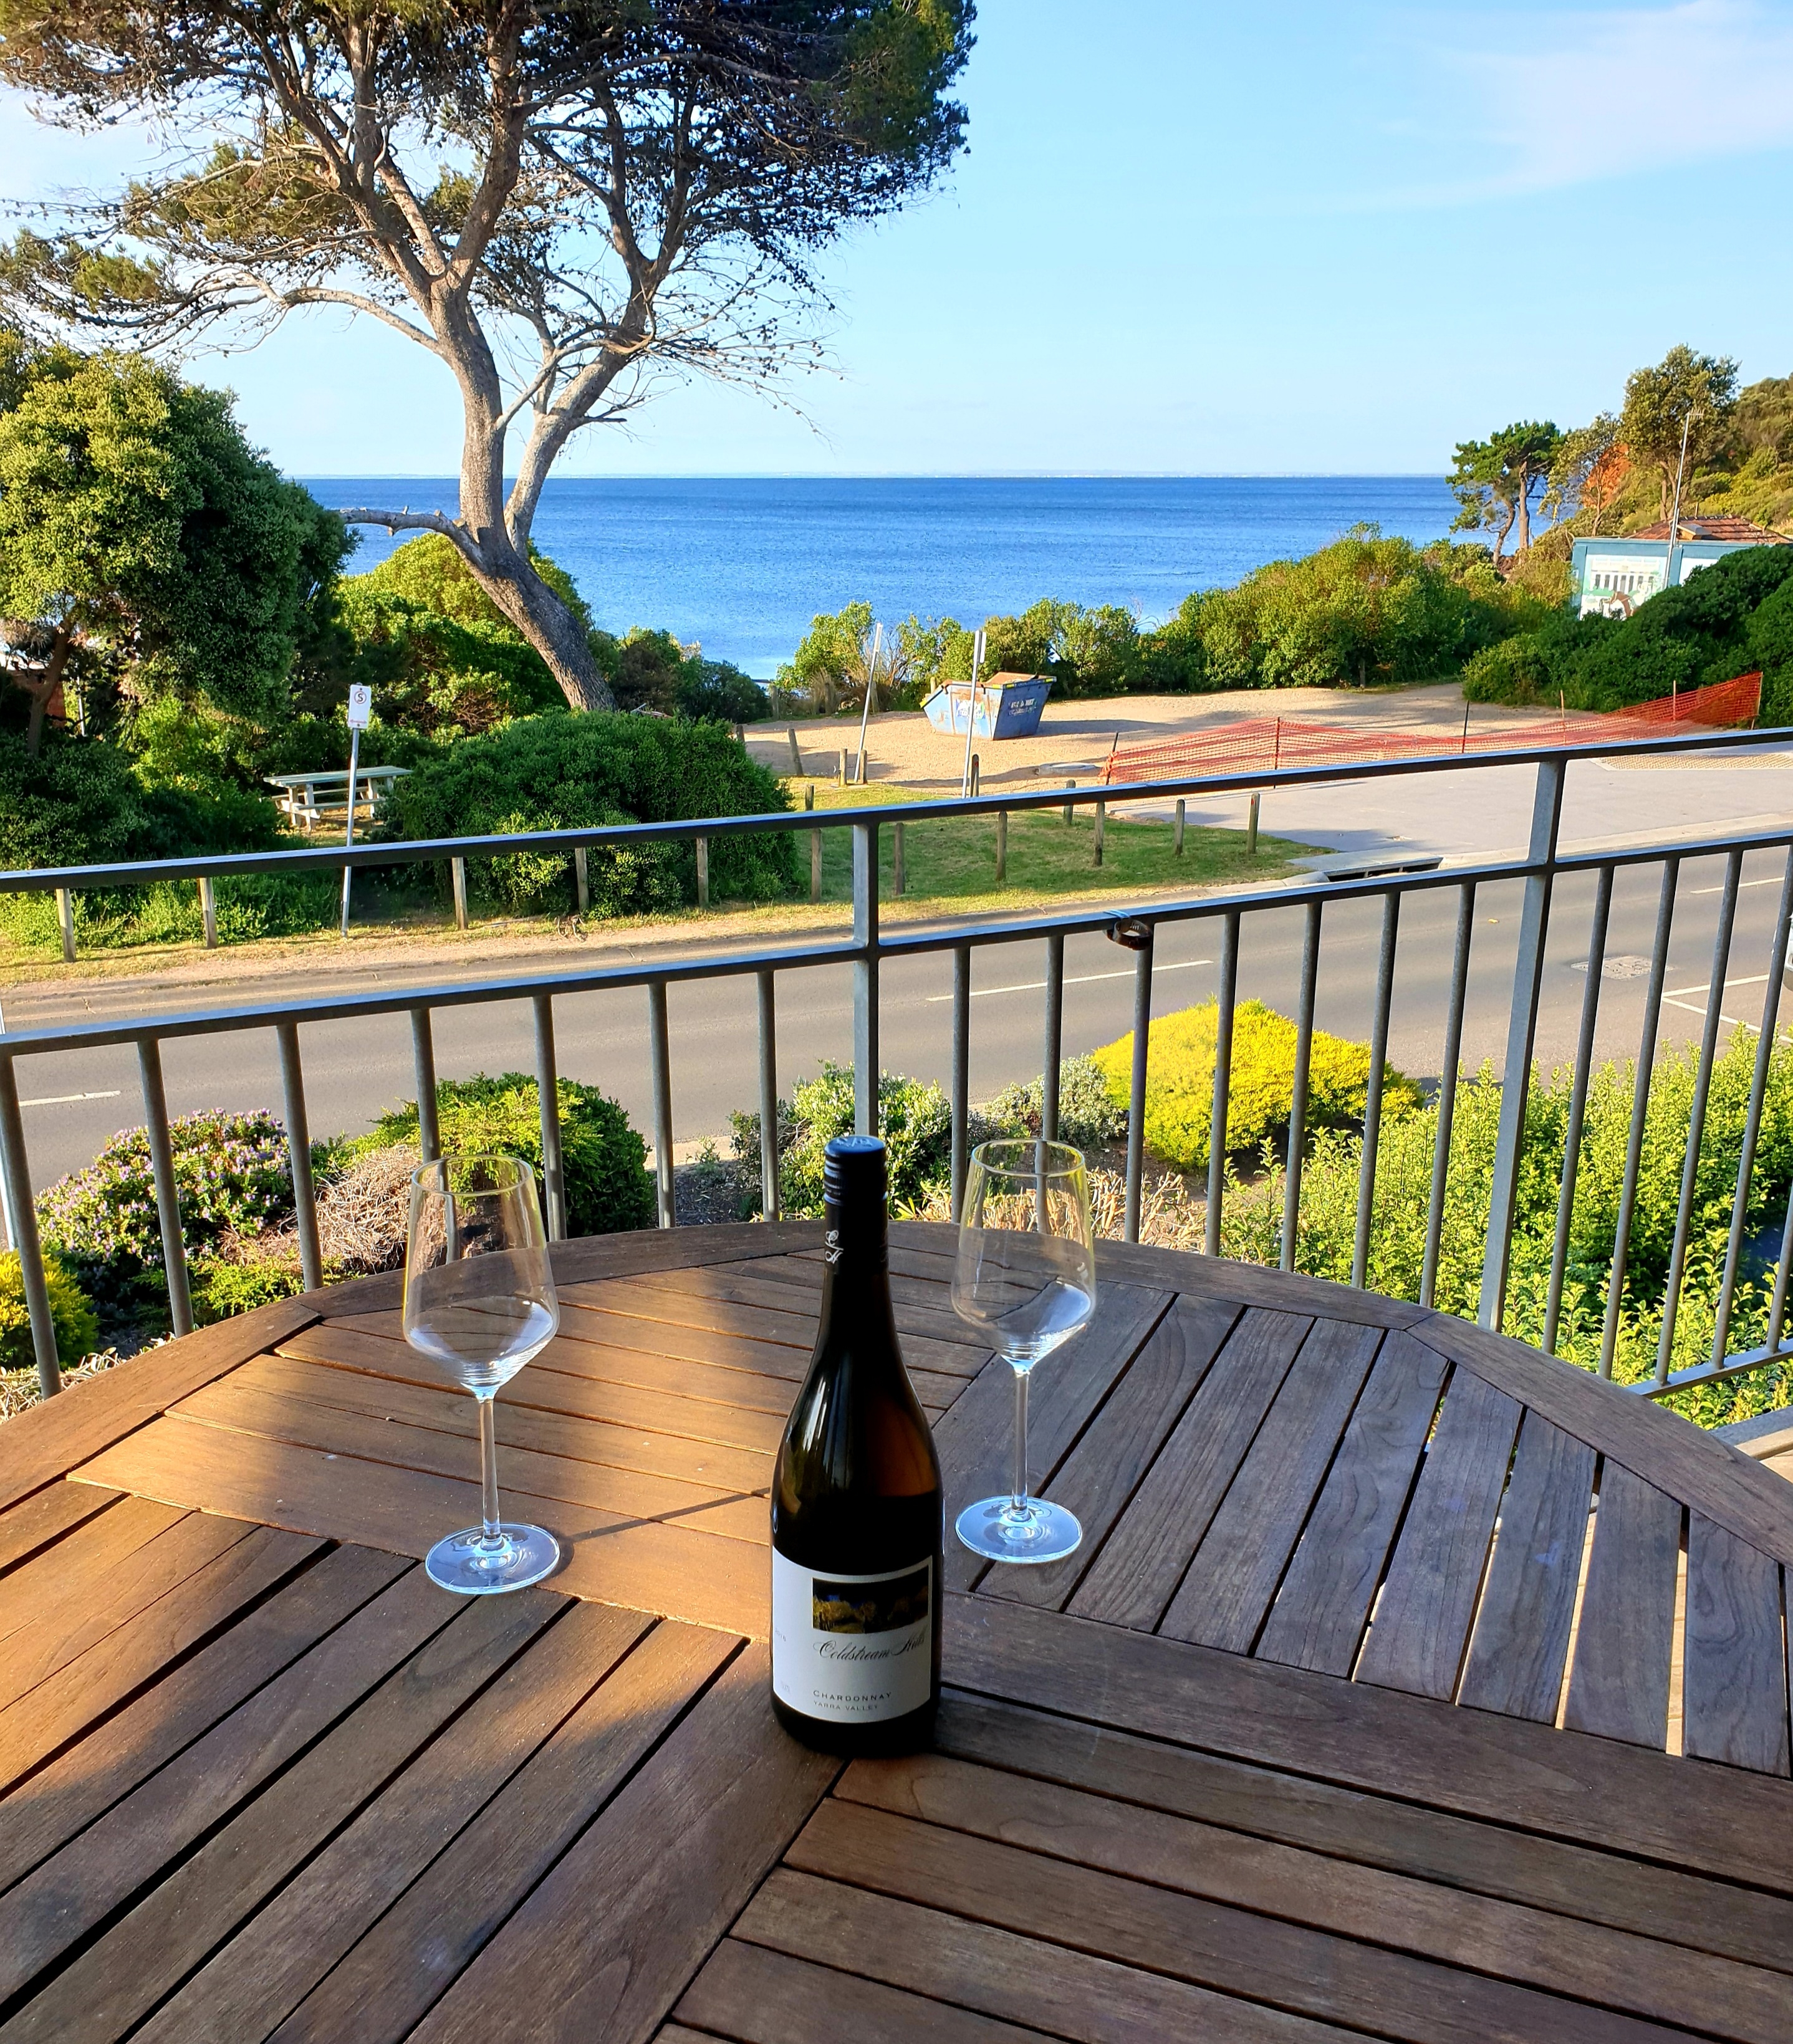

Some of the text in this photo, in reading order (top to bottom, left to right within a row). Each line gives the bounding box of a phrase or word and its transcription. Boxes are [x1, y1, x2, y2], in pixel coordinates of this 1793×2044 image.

[357, 693, 363, 702] S
[812, 1639, 890, 1661] Coldstream
[813, 1690, 892, 1702] CHARDONNAY
[814, 1701, 841, 1710] YARRA
